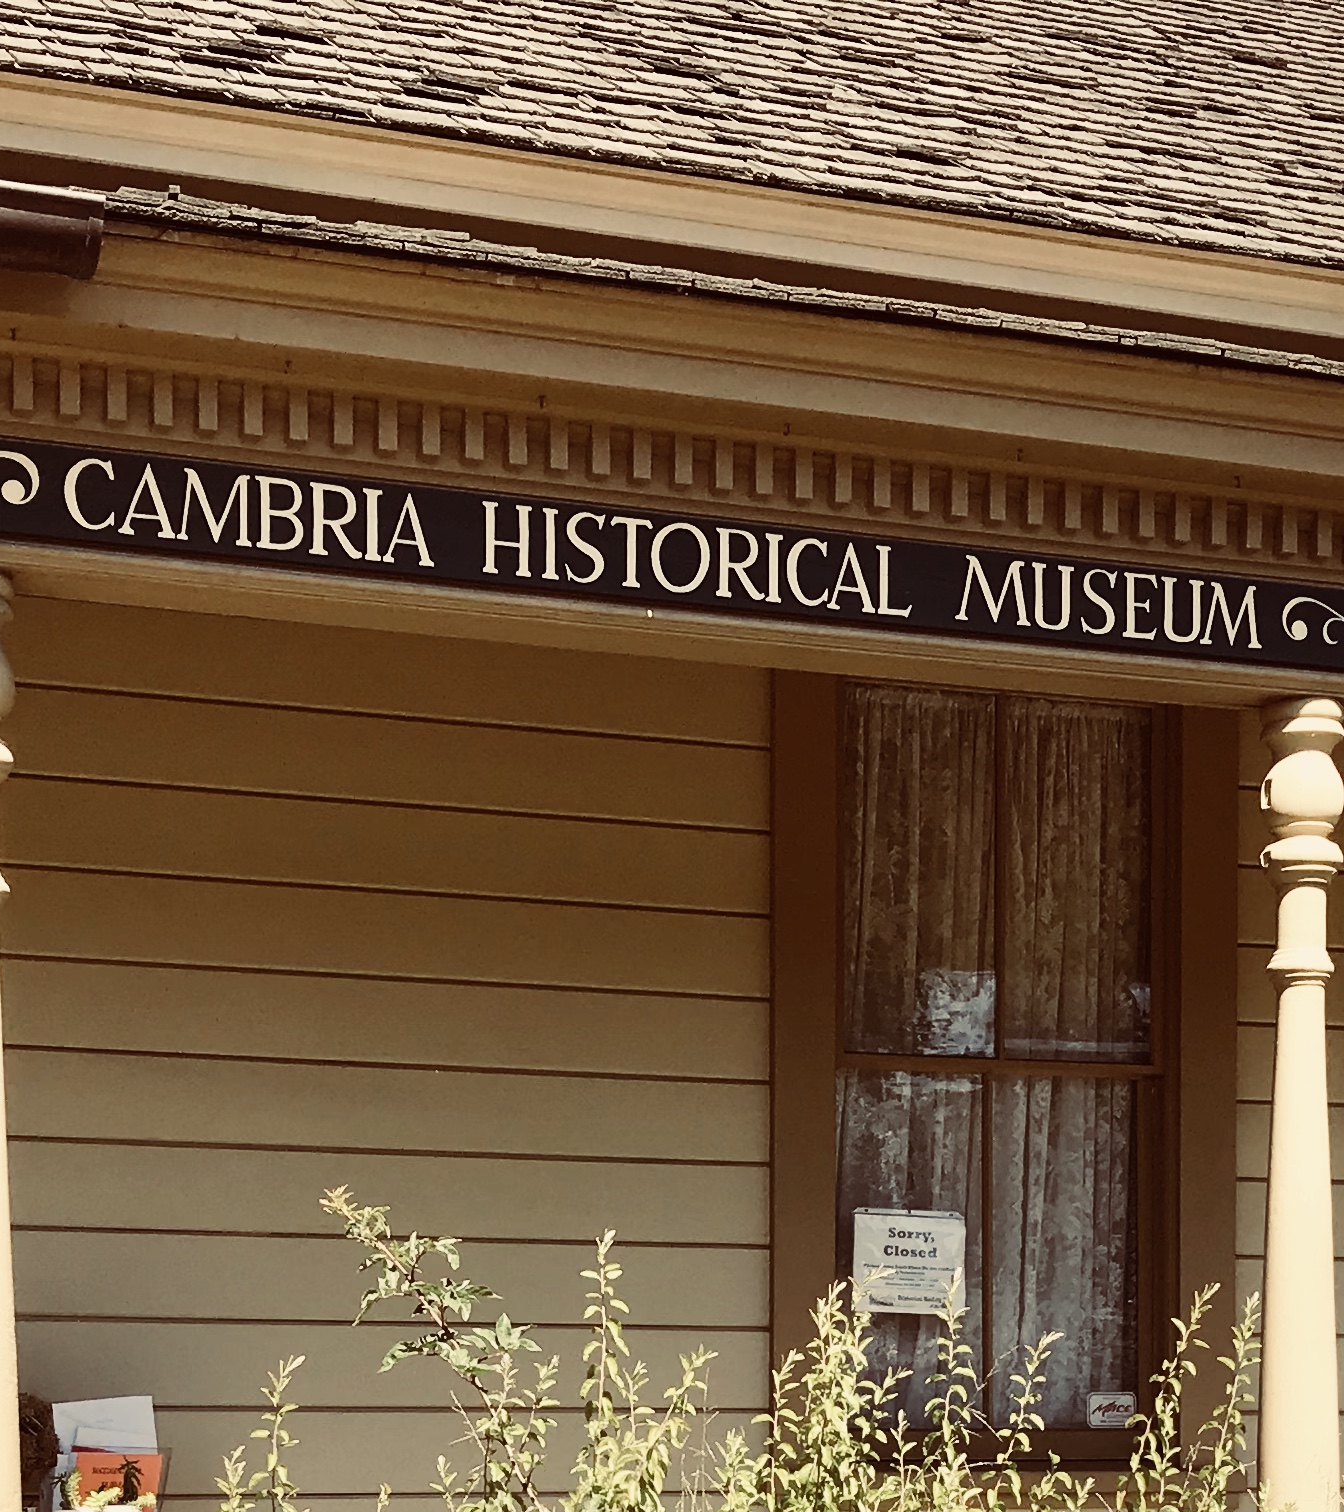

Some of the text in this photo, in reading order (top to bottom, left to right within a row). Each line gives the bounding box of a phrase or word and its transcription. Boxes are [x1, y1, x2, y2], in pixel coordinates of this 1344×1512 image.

[64, 459, 1262, 648] CAMBRIA HISTORICAL MUSEUM
[888, 1227, 935, 1243] Sorry,
[883, 1245, 938, 1258] Closed
